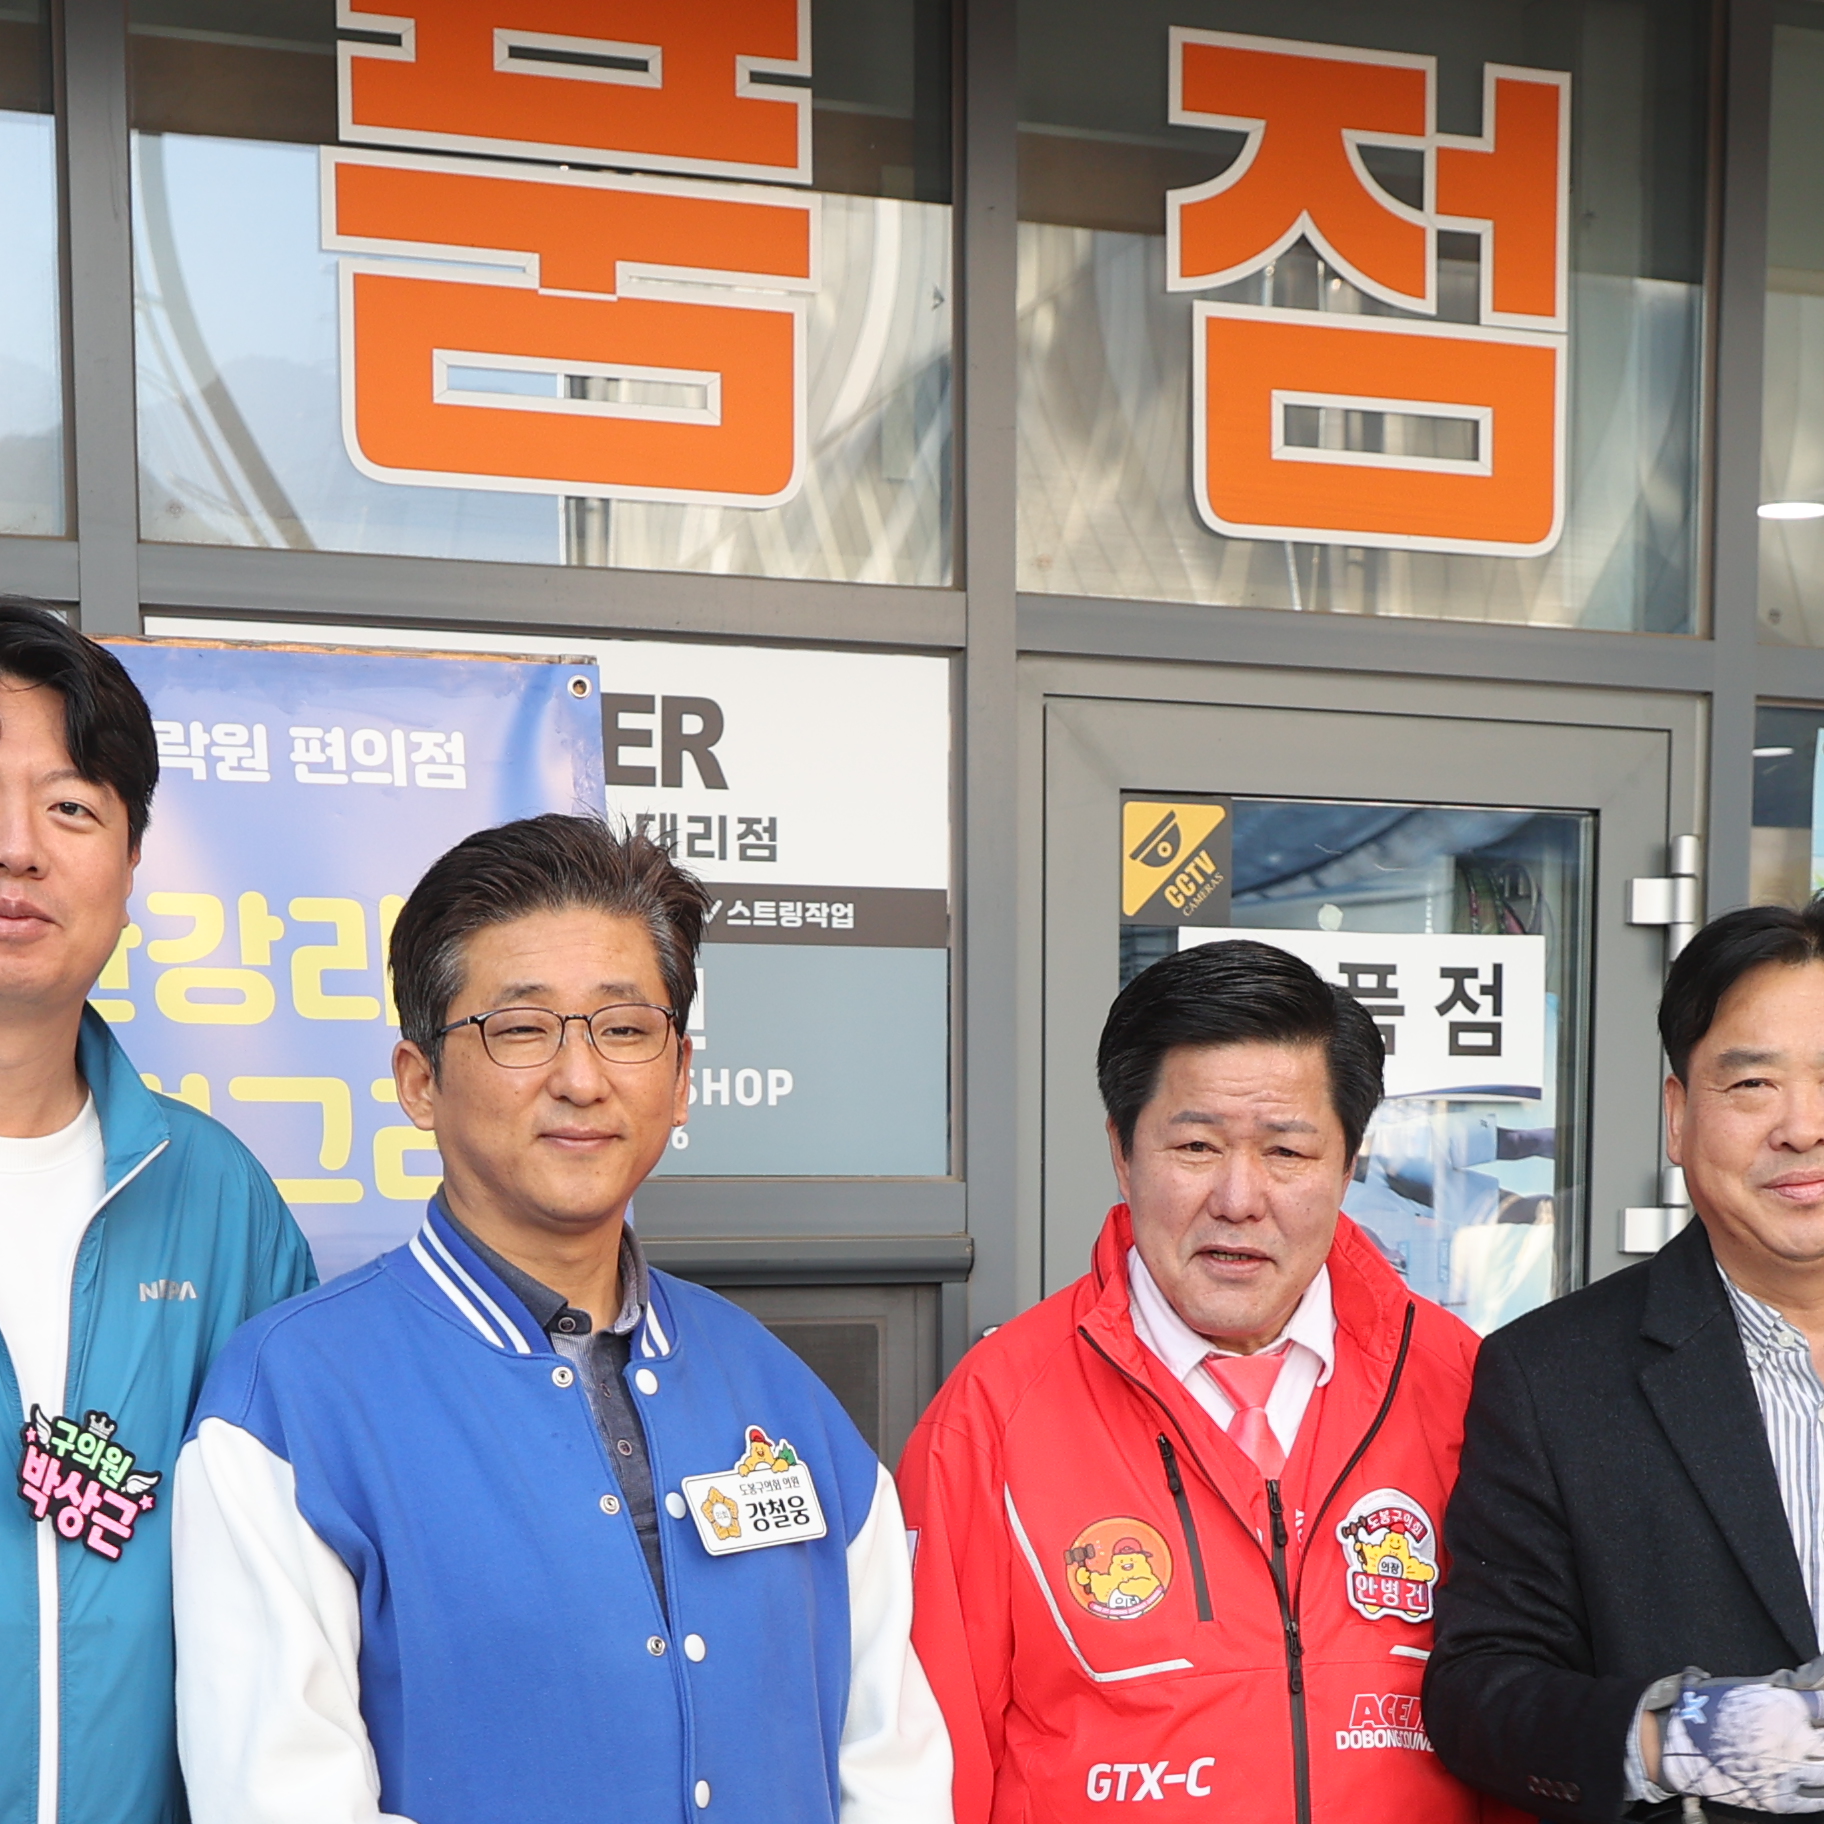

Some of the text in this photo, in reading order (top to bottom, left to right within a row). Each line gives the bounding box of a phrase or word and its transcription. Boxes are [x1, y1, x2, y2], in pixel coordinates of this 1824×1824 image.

[288, 724, 468, 792] 편의점
[1163, 849, 1217, 909] CCTV
[1182, 871, 1225, 917] CAMERAS
[726, 899, 855, 930] 스트링작업
[50, 1418, 134, 1490] 구의원
[21, 1444, 139, 1560] 박상근
[738, 1478, 782, 1497] 도봉구의회
[745, 1495, 811, 1533] 강철웅
[1367, 1509, 1424, 1538] 도봉구의회
[1355, 1574, 1427, 1612] 안병건
[1085, 1756, 1216, 1802] GTX-C
